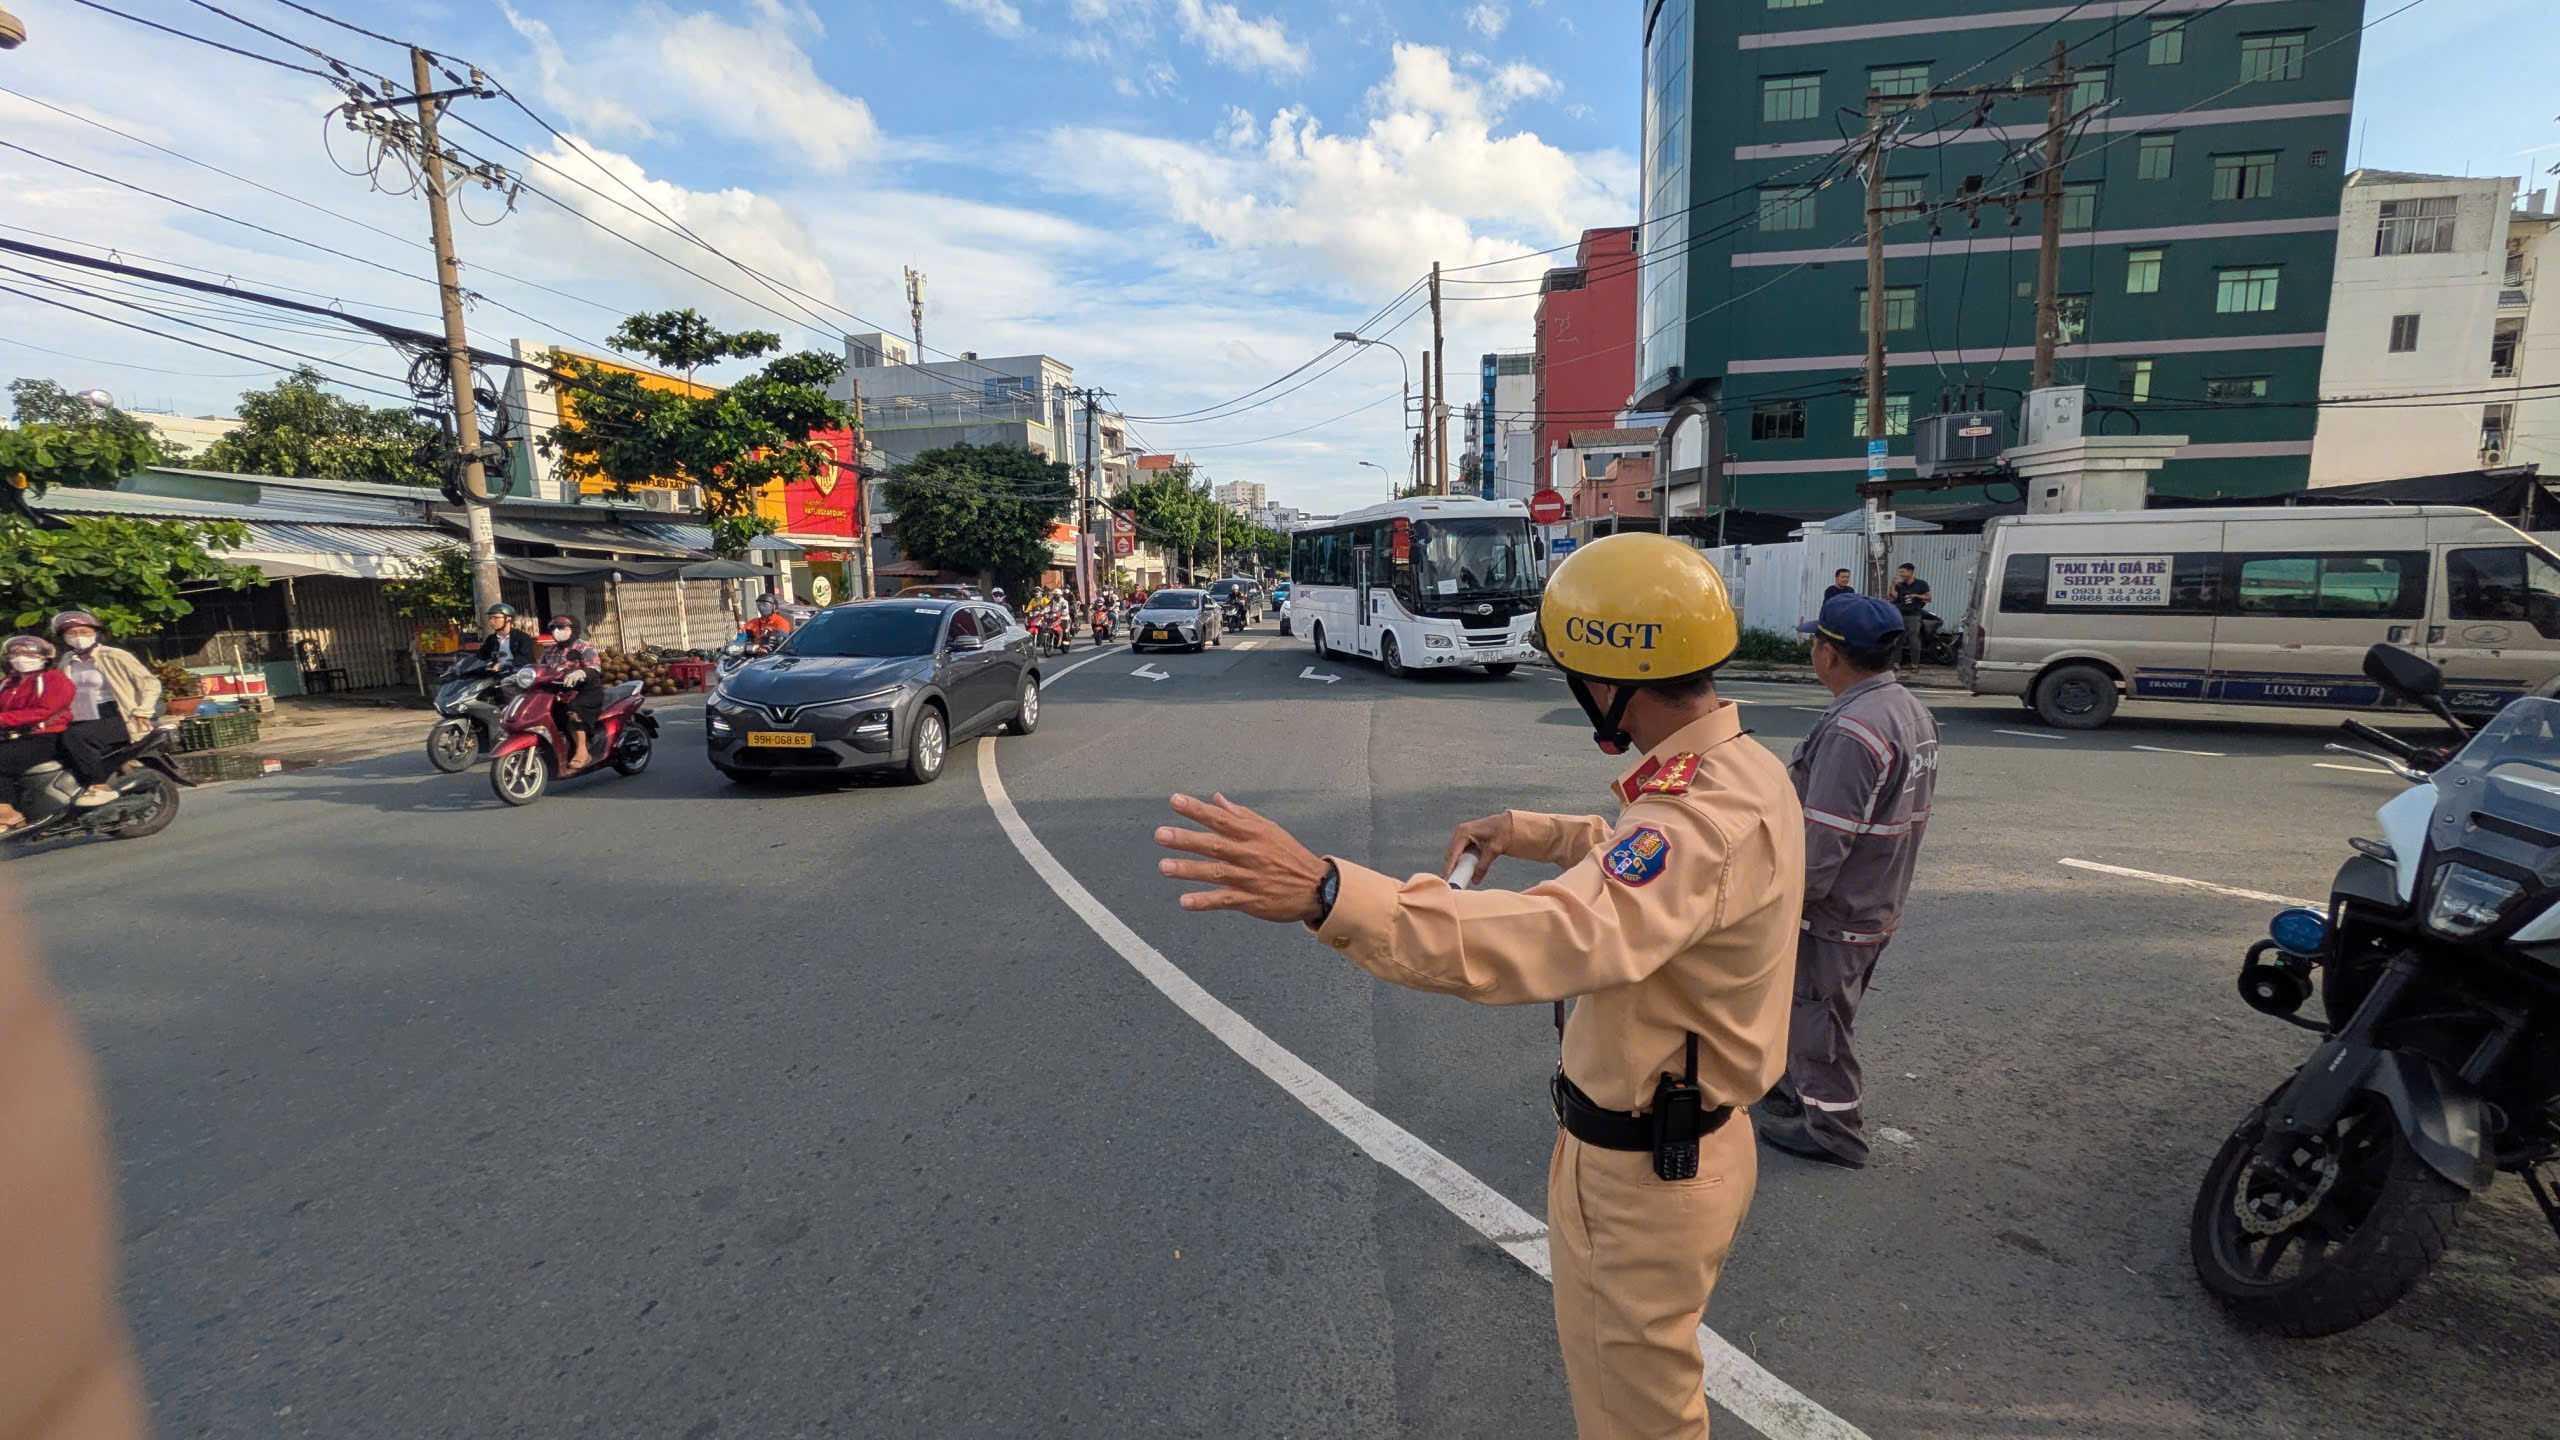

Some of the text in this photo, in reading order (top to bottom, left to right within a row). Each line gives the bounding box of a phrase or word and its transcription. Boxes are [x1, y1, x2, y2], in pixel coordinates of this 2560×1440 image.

[2055, 563, 2088, 574] TAXI
[2063, 576, 2156, 586] SHIPP 24H
[1566, 616, 1662, 649] CSGT
[2149, 681, 2188, 689] TRANSIT
[2263, 684, 2332, 697] LUXURY
[2451, 692, 2501, 707] Ford
